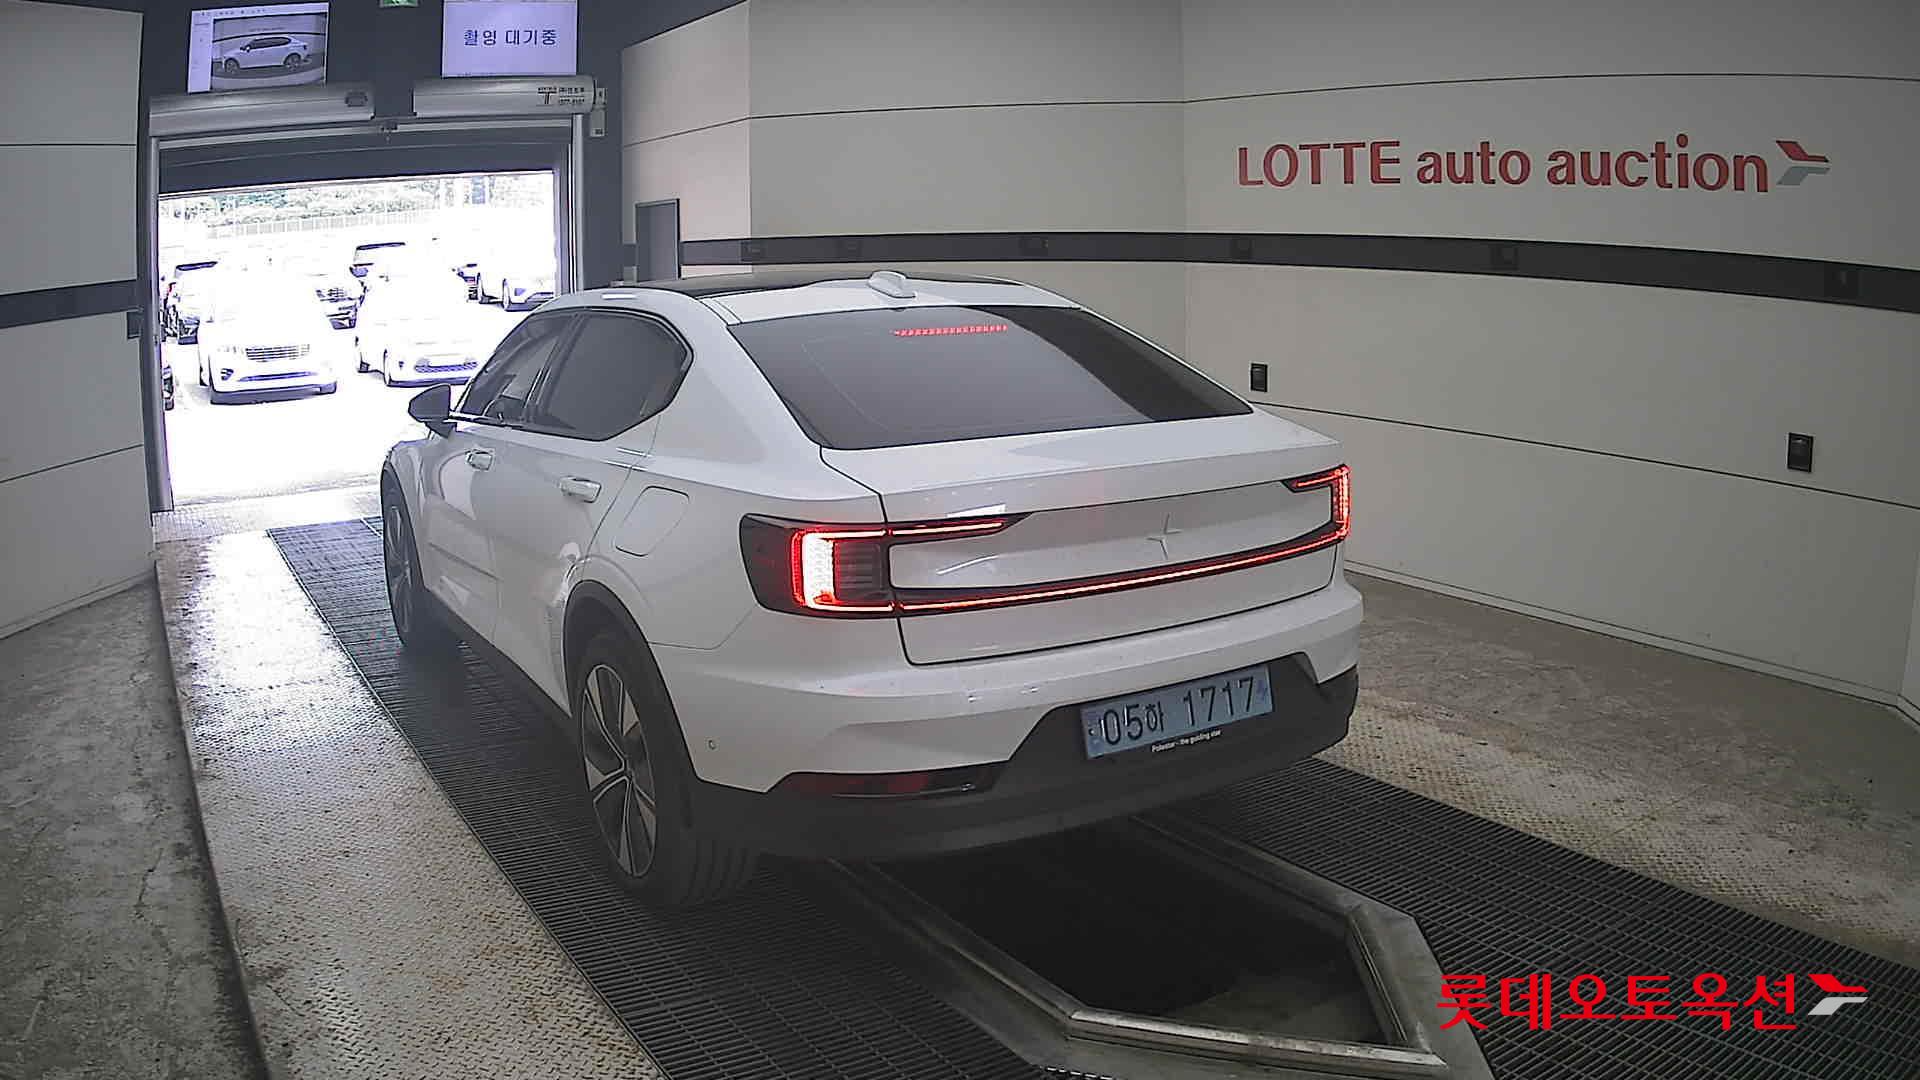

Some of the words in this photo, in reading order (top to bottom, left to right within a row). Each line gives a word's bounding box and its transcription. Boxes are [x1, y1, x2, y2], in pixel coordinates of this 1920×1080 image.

[464, 29, 497, 46] 촬영
[504, 29, 557, 46] 대기중
[1239, 141, 1401, 187] LOTTE
[1416, 141, 1531, 186] auto
[1546, 133, 1769, 192] auction
[1101, 701, 1164, 746] 05하
[1183, 676, 1254, 727] 1717
